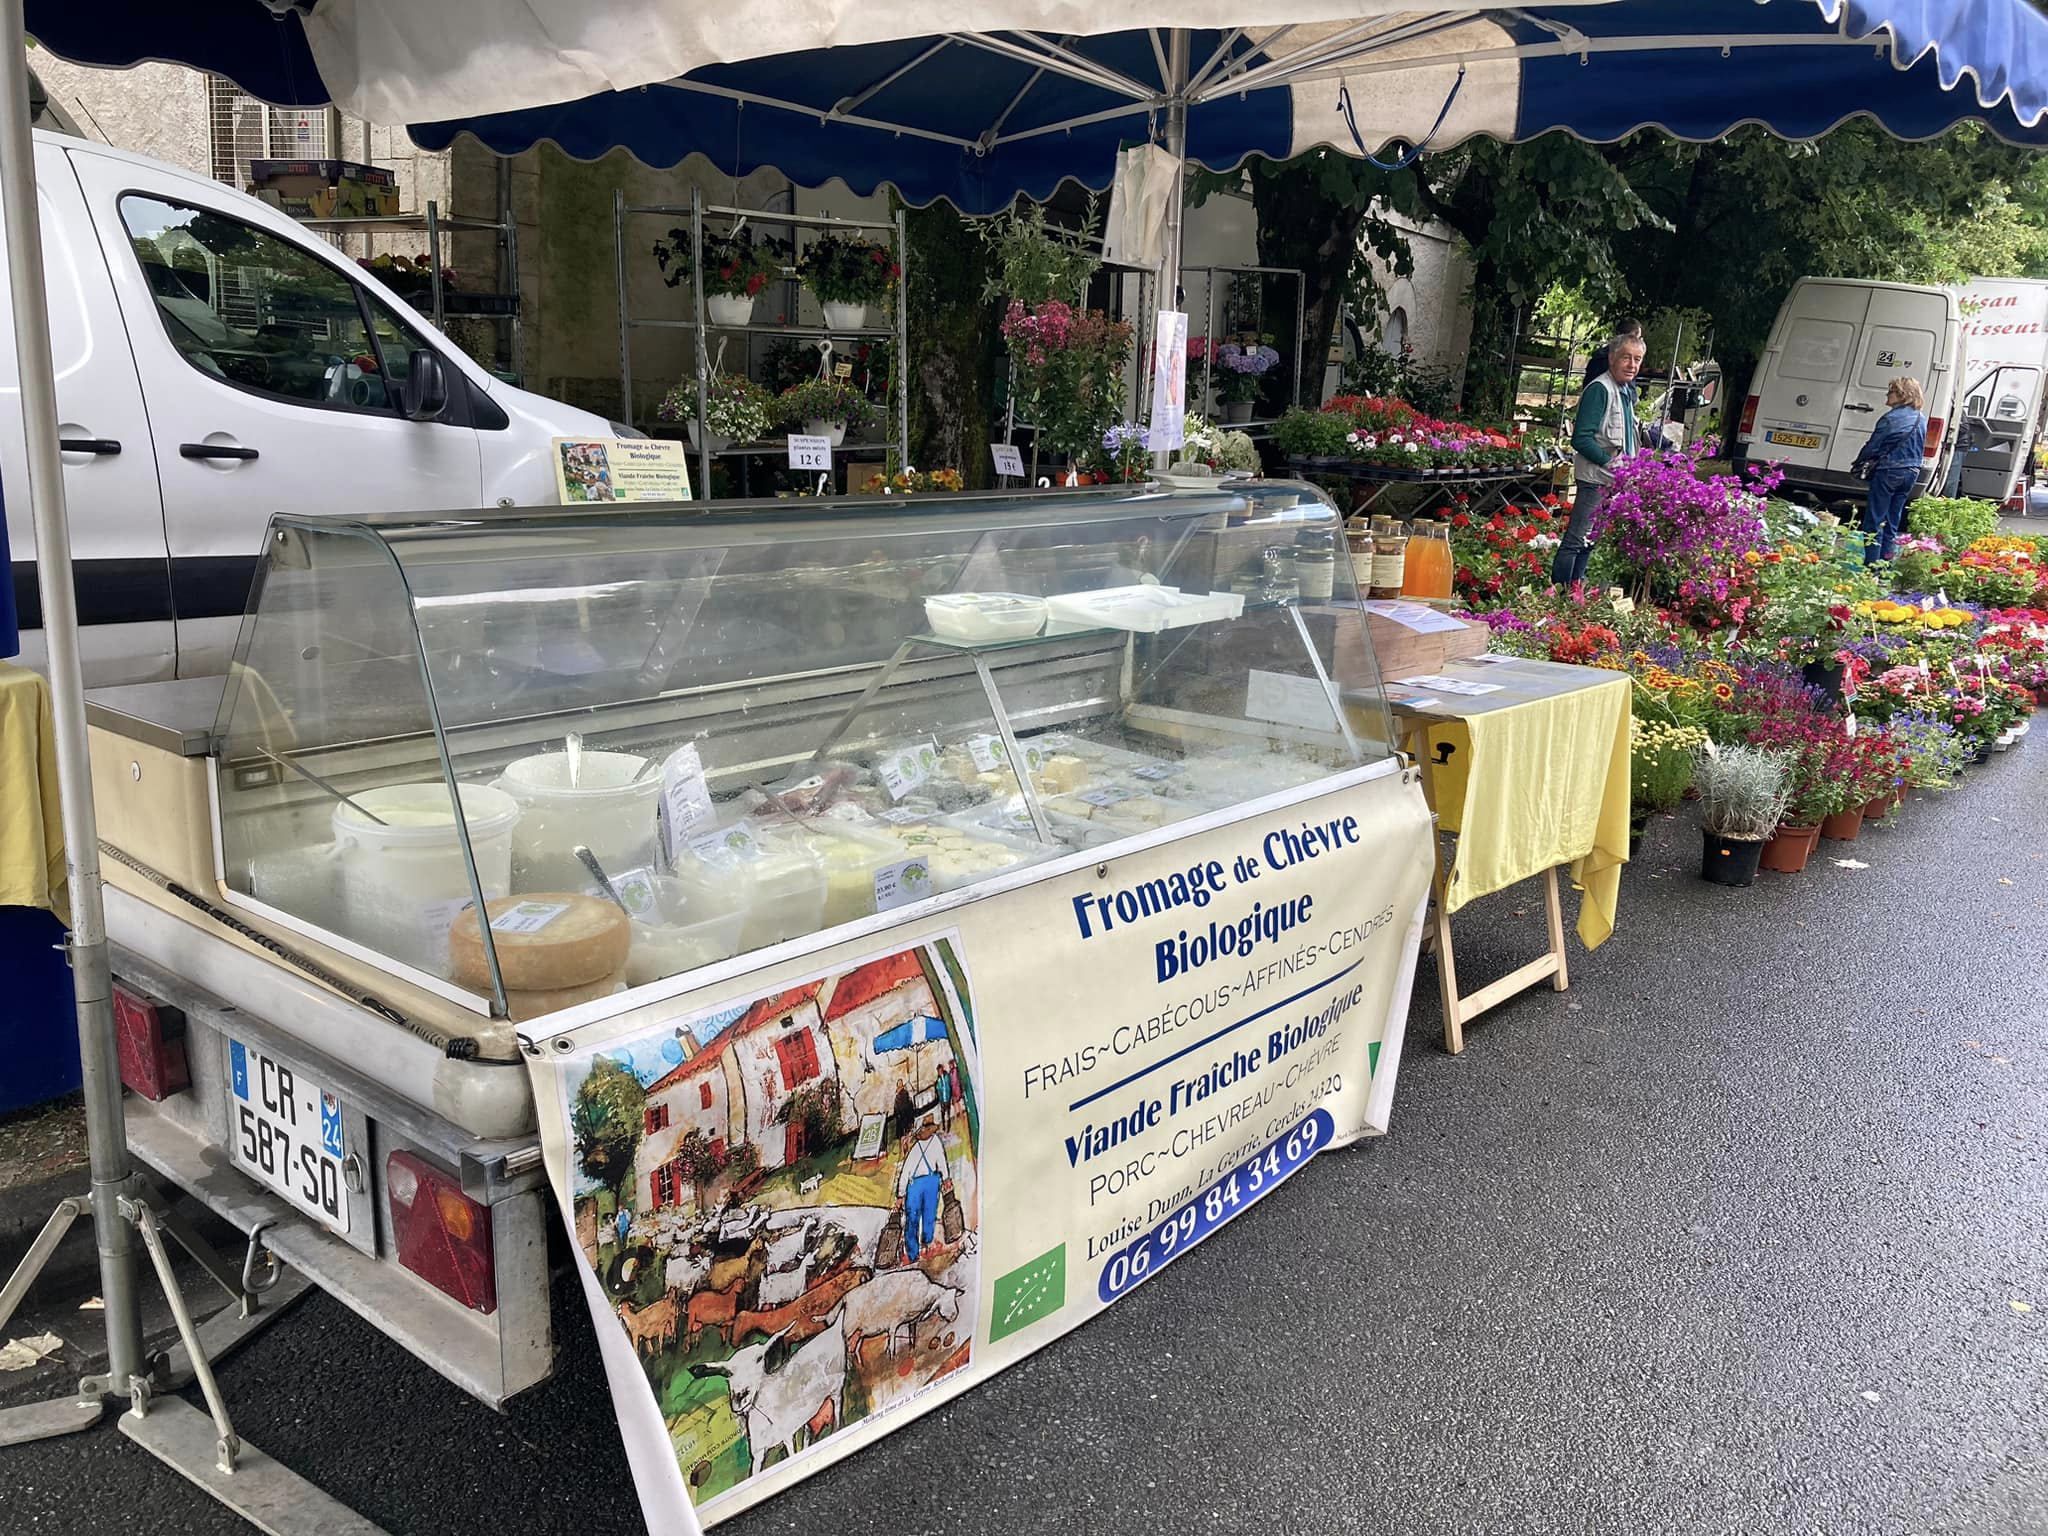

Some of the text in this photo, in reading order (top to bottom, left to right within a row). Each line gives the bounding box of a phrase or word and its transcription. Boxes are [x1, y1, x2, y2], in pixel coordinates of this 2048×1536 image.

[800, 454, 822, 465] 12 €
[1773, 432, 1793, 443] 1525
[1072, 815, 1360, 939] Fromage de Chèvre
[1154, 893, 1314, 984] Biologique
[236, 1071, 242, 1086] F
[322, 1118, 341, 1152] 24
[1064, 984, 1363, 1168] Viande Fraîche Biologique
[1087, 1212, 1142, 1262] Louise
[1146, 1182, 1193, 1225] Dunn,
[1197, 1167, 1213, 1190] La
[1265, 1101, 1306, 1139] Cercles
[1108, 1117, 1319, 1293] 06 99 84 34 69
